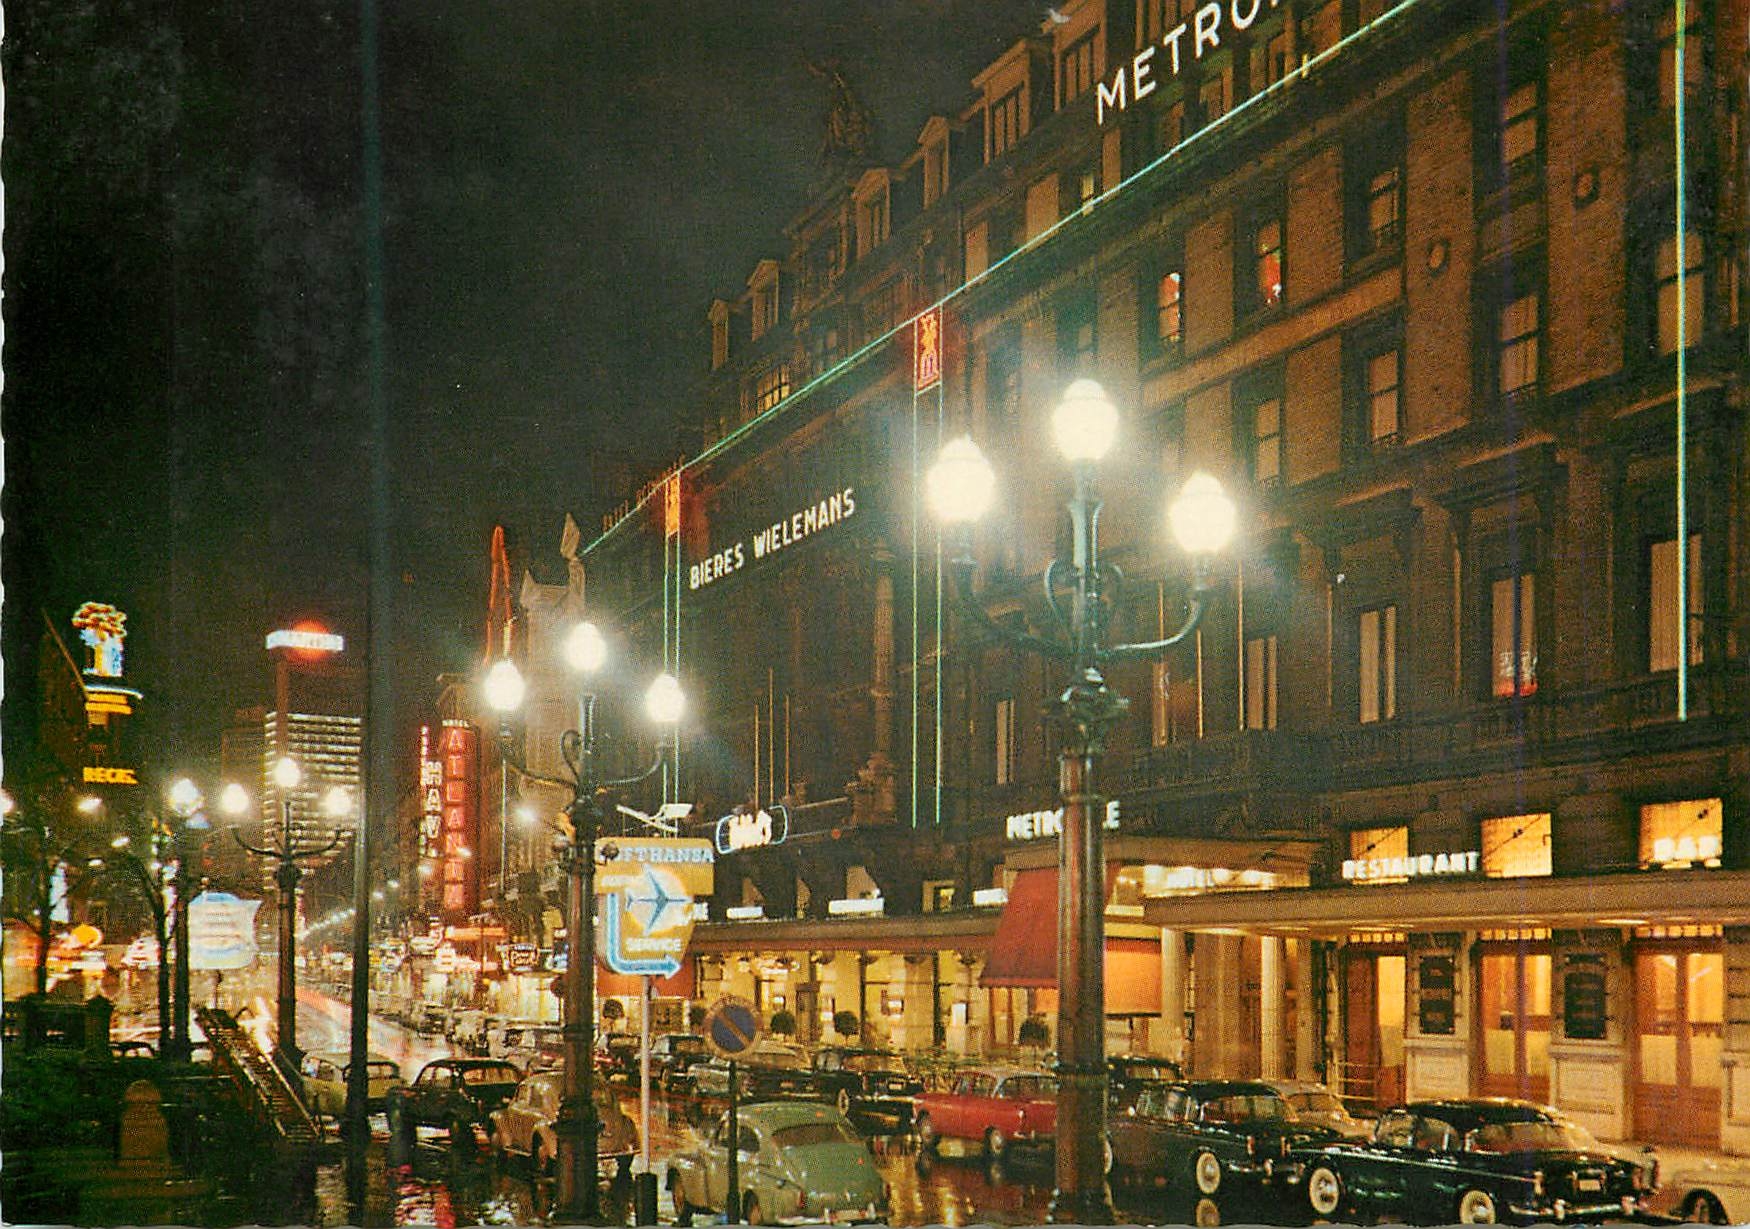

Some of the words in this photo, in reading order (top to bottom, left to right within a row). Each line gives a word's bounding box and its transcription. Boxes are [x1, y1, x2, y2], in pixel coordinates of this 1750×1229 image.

[689, 542, 745, 591] BIERES
[753, 487, 856, 560] WIELEMANS
[1653, 835, 1720, 863] BAR
[1341, 850, 1479, 880] RESTAURANT
